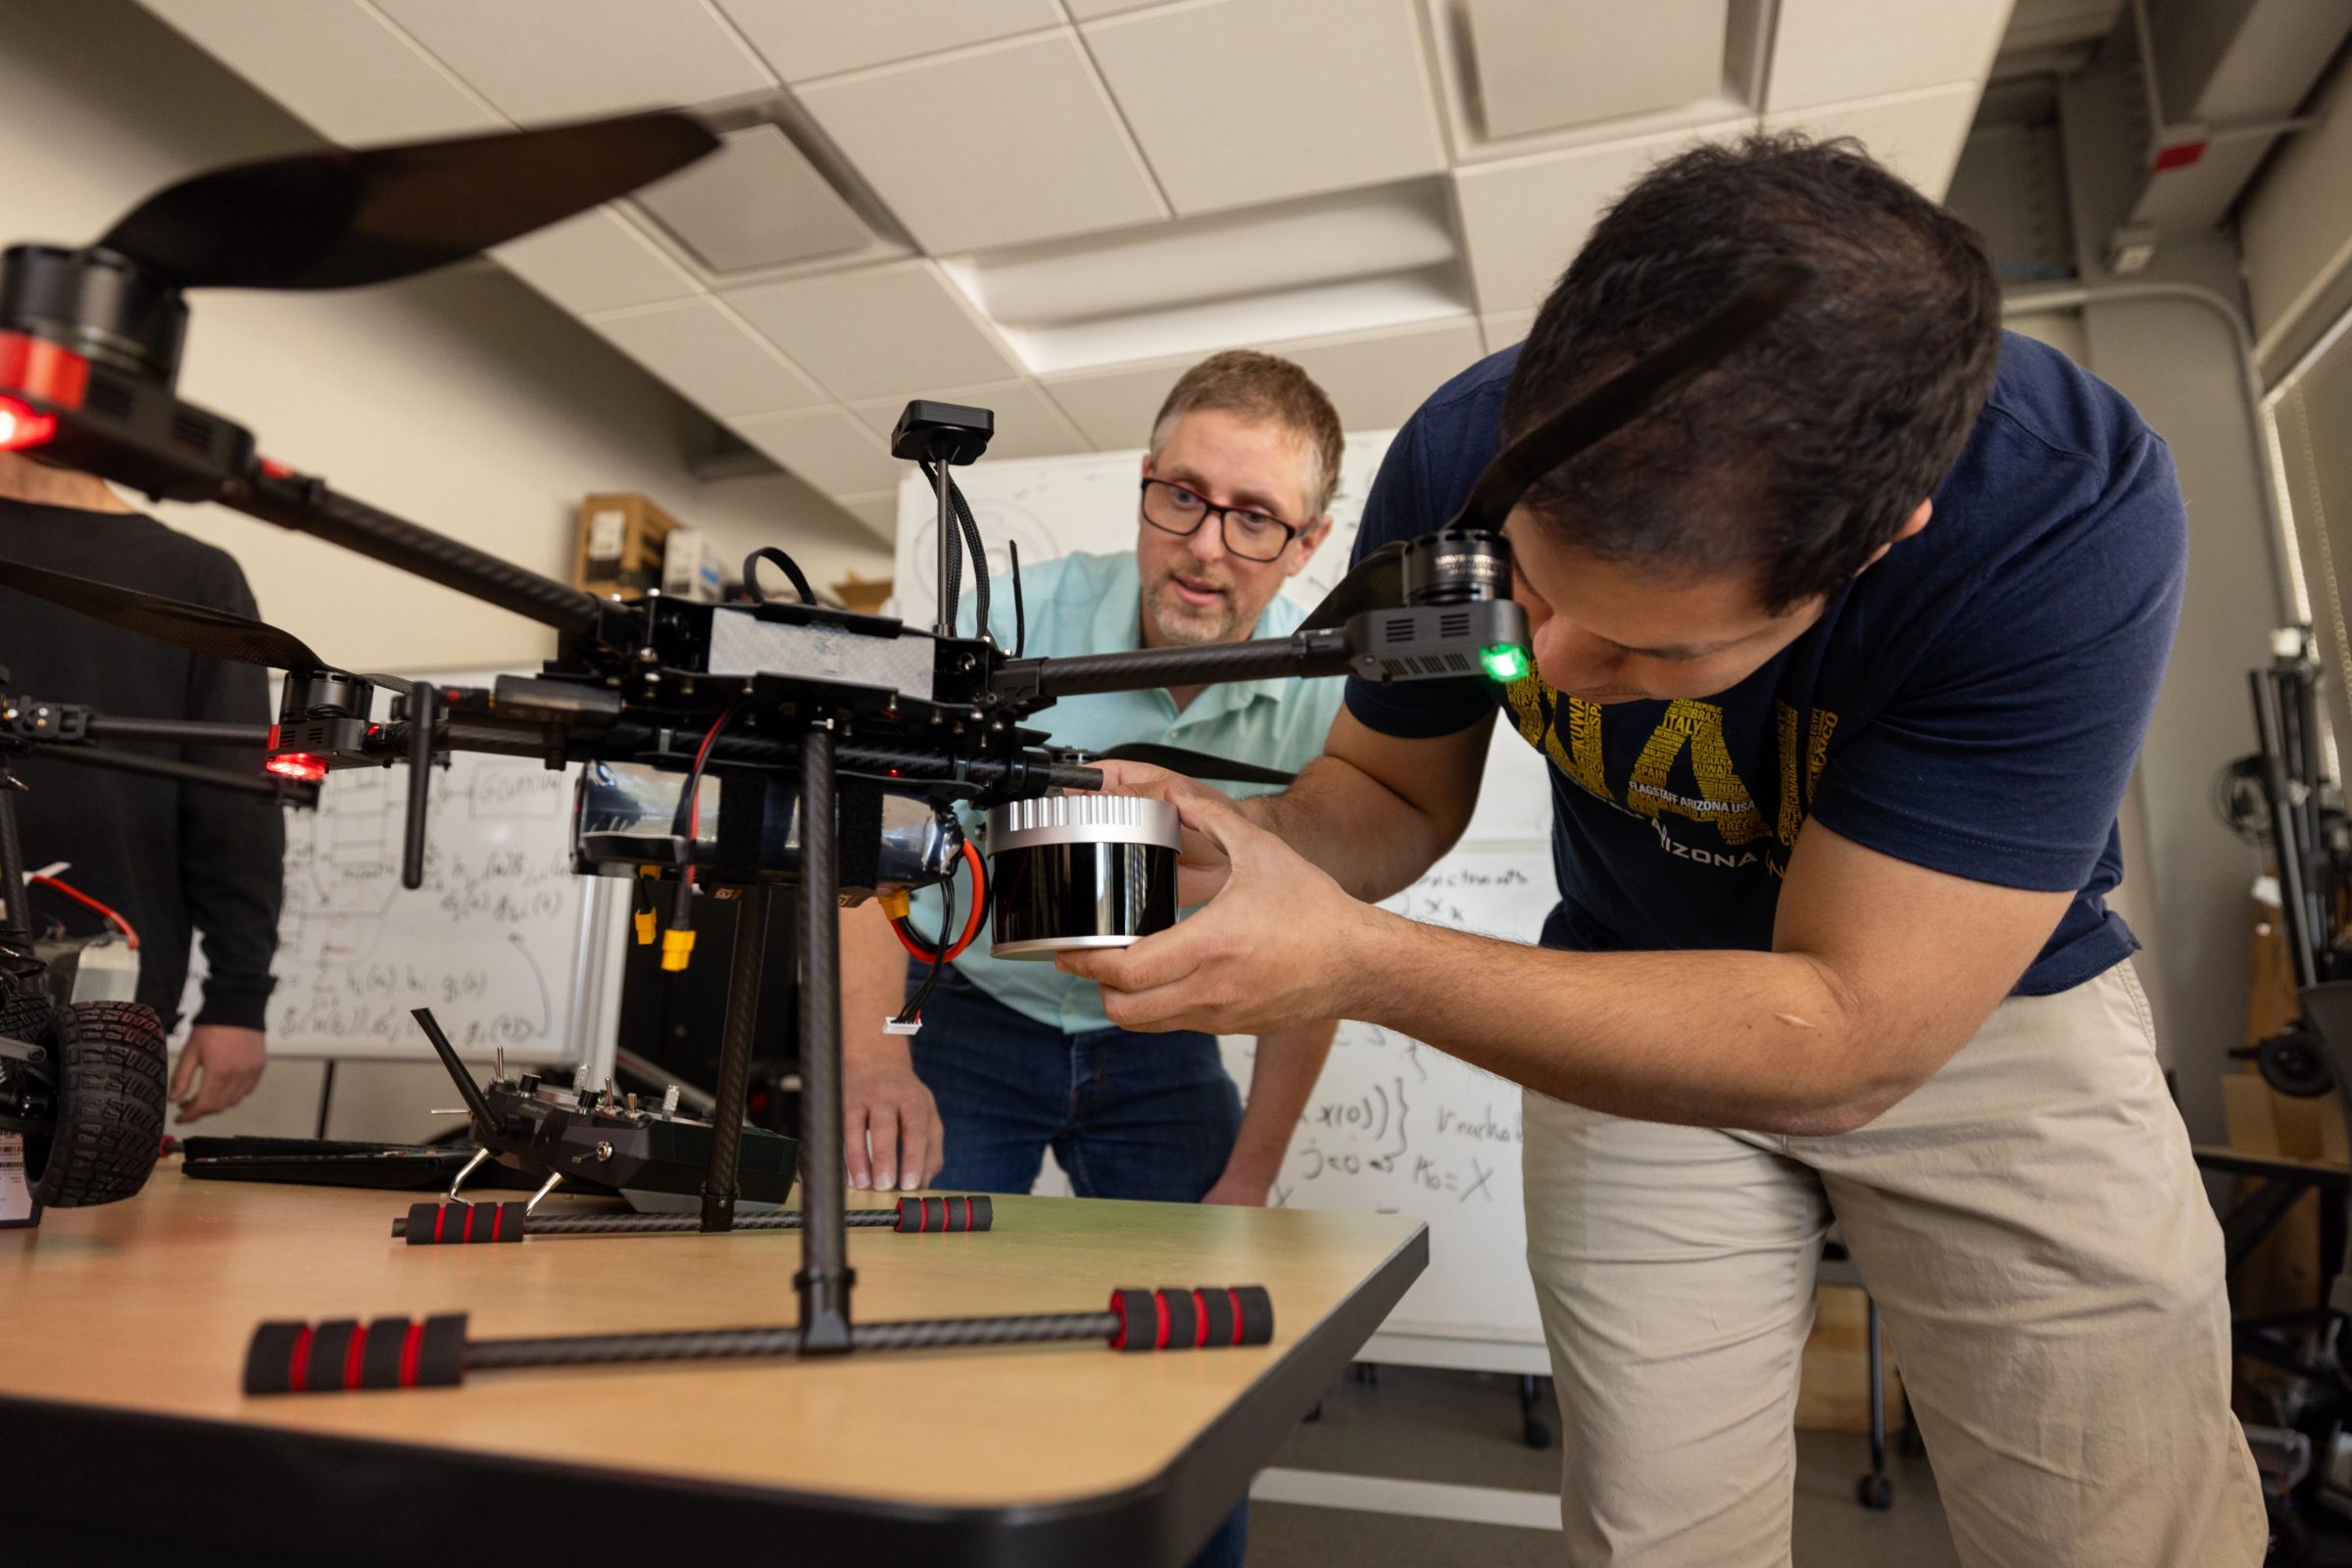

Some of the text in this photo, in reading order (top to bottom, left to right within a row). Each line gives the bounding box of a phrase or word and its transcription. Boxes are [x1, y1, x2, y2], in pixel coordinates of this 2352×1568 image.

[1662, 712, 1703, 736] ITALY
[1692, 762, 1733, 775] KUWAIT
[1701, 756, 1734, 768] GHANA
[1634, 763, 1668, 780] SPAIN
[1715, 783, 1747, 794] INDIA
[1629, 781, 1756, 813] FLAGSTAFF ARIZONA USA
